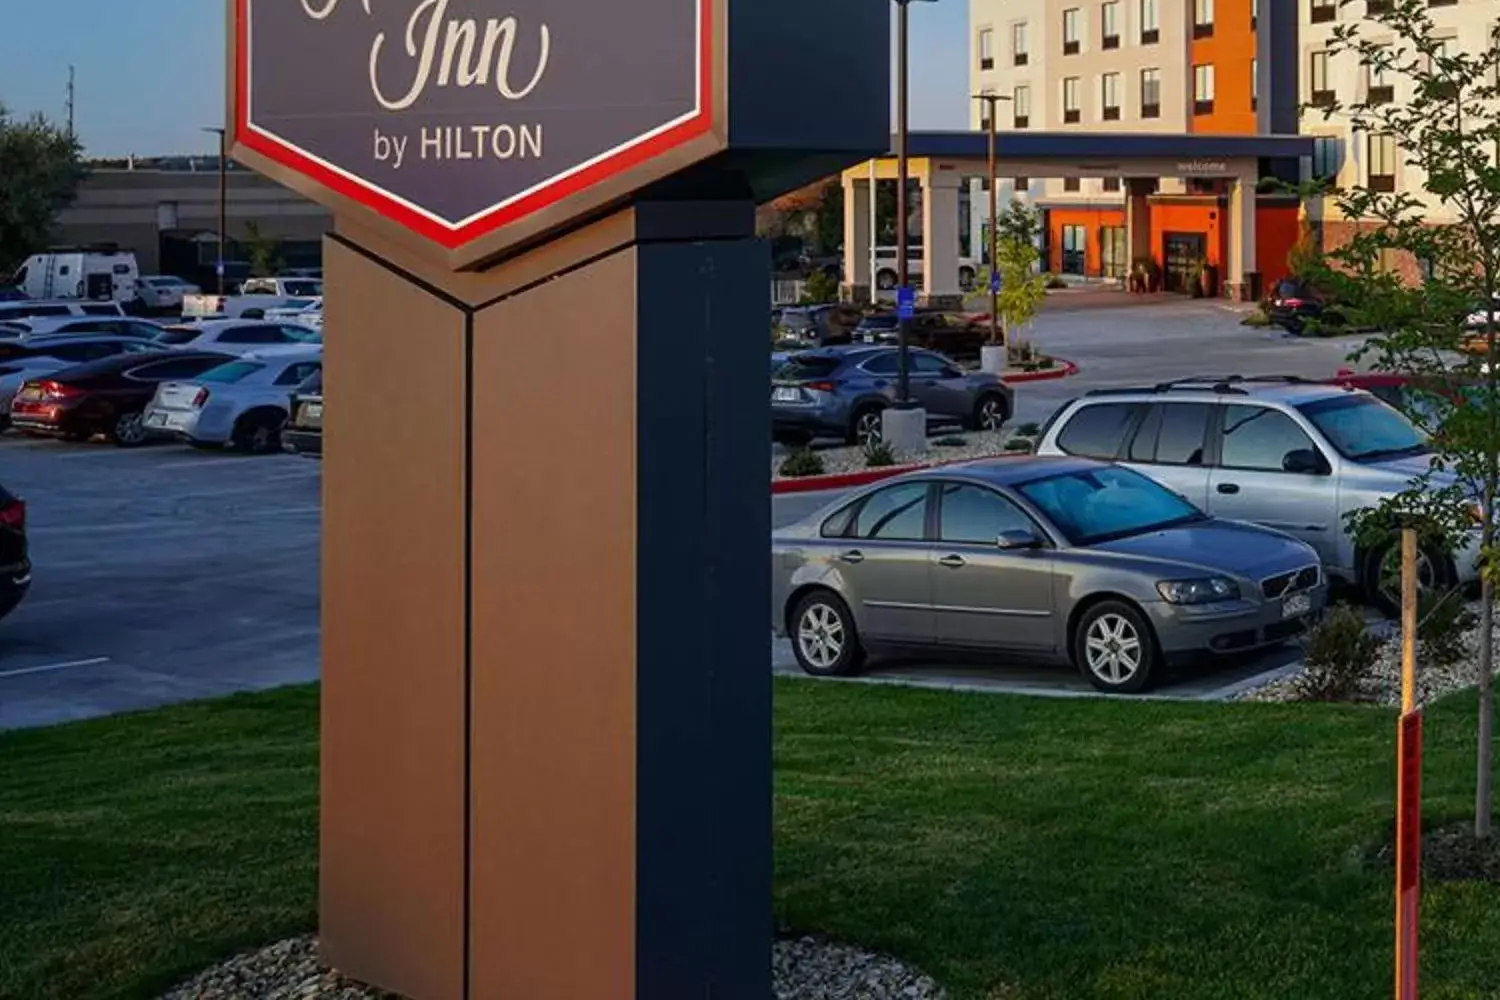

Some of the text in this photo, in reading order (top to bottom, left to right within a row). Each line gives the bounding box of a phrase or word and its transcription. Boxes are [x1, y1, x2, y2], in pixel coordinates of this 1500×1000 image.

[374, 123, 543, 169] by HILTON
[1178, 160, 1226, 172] welcome
